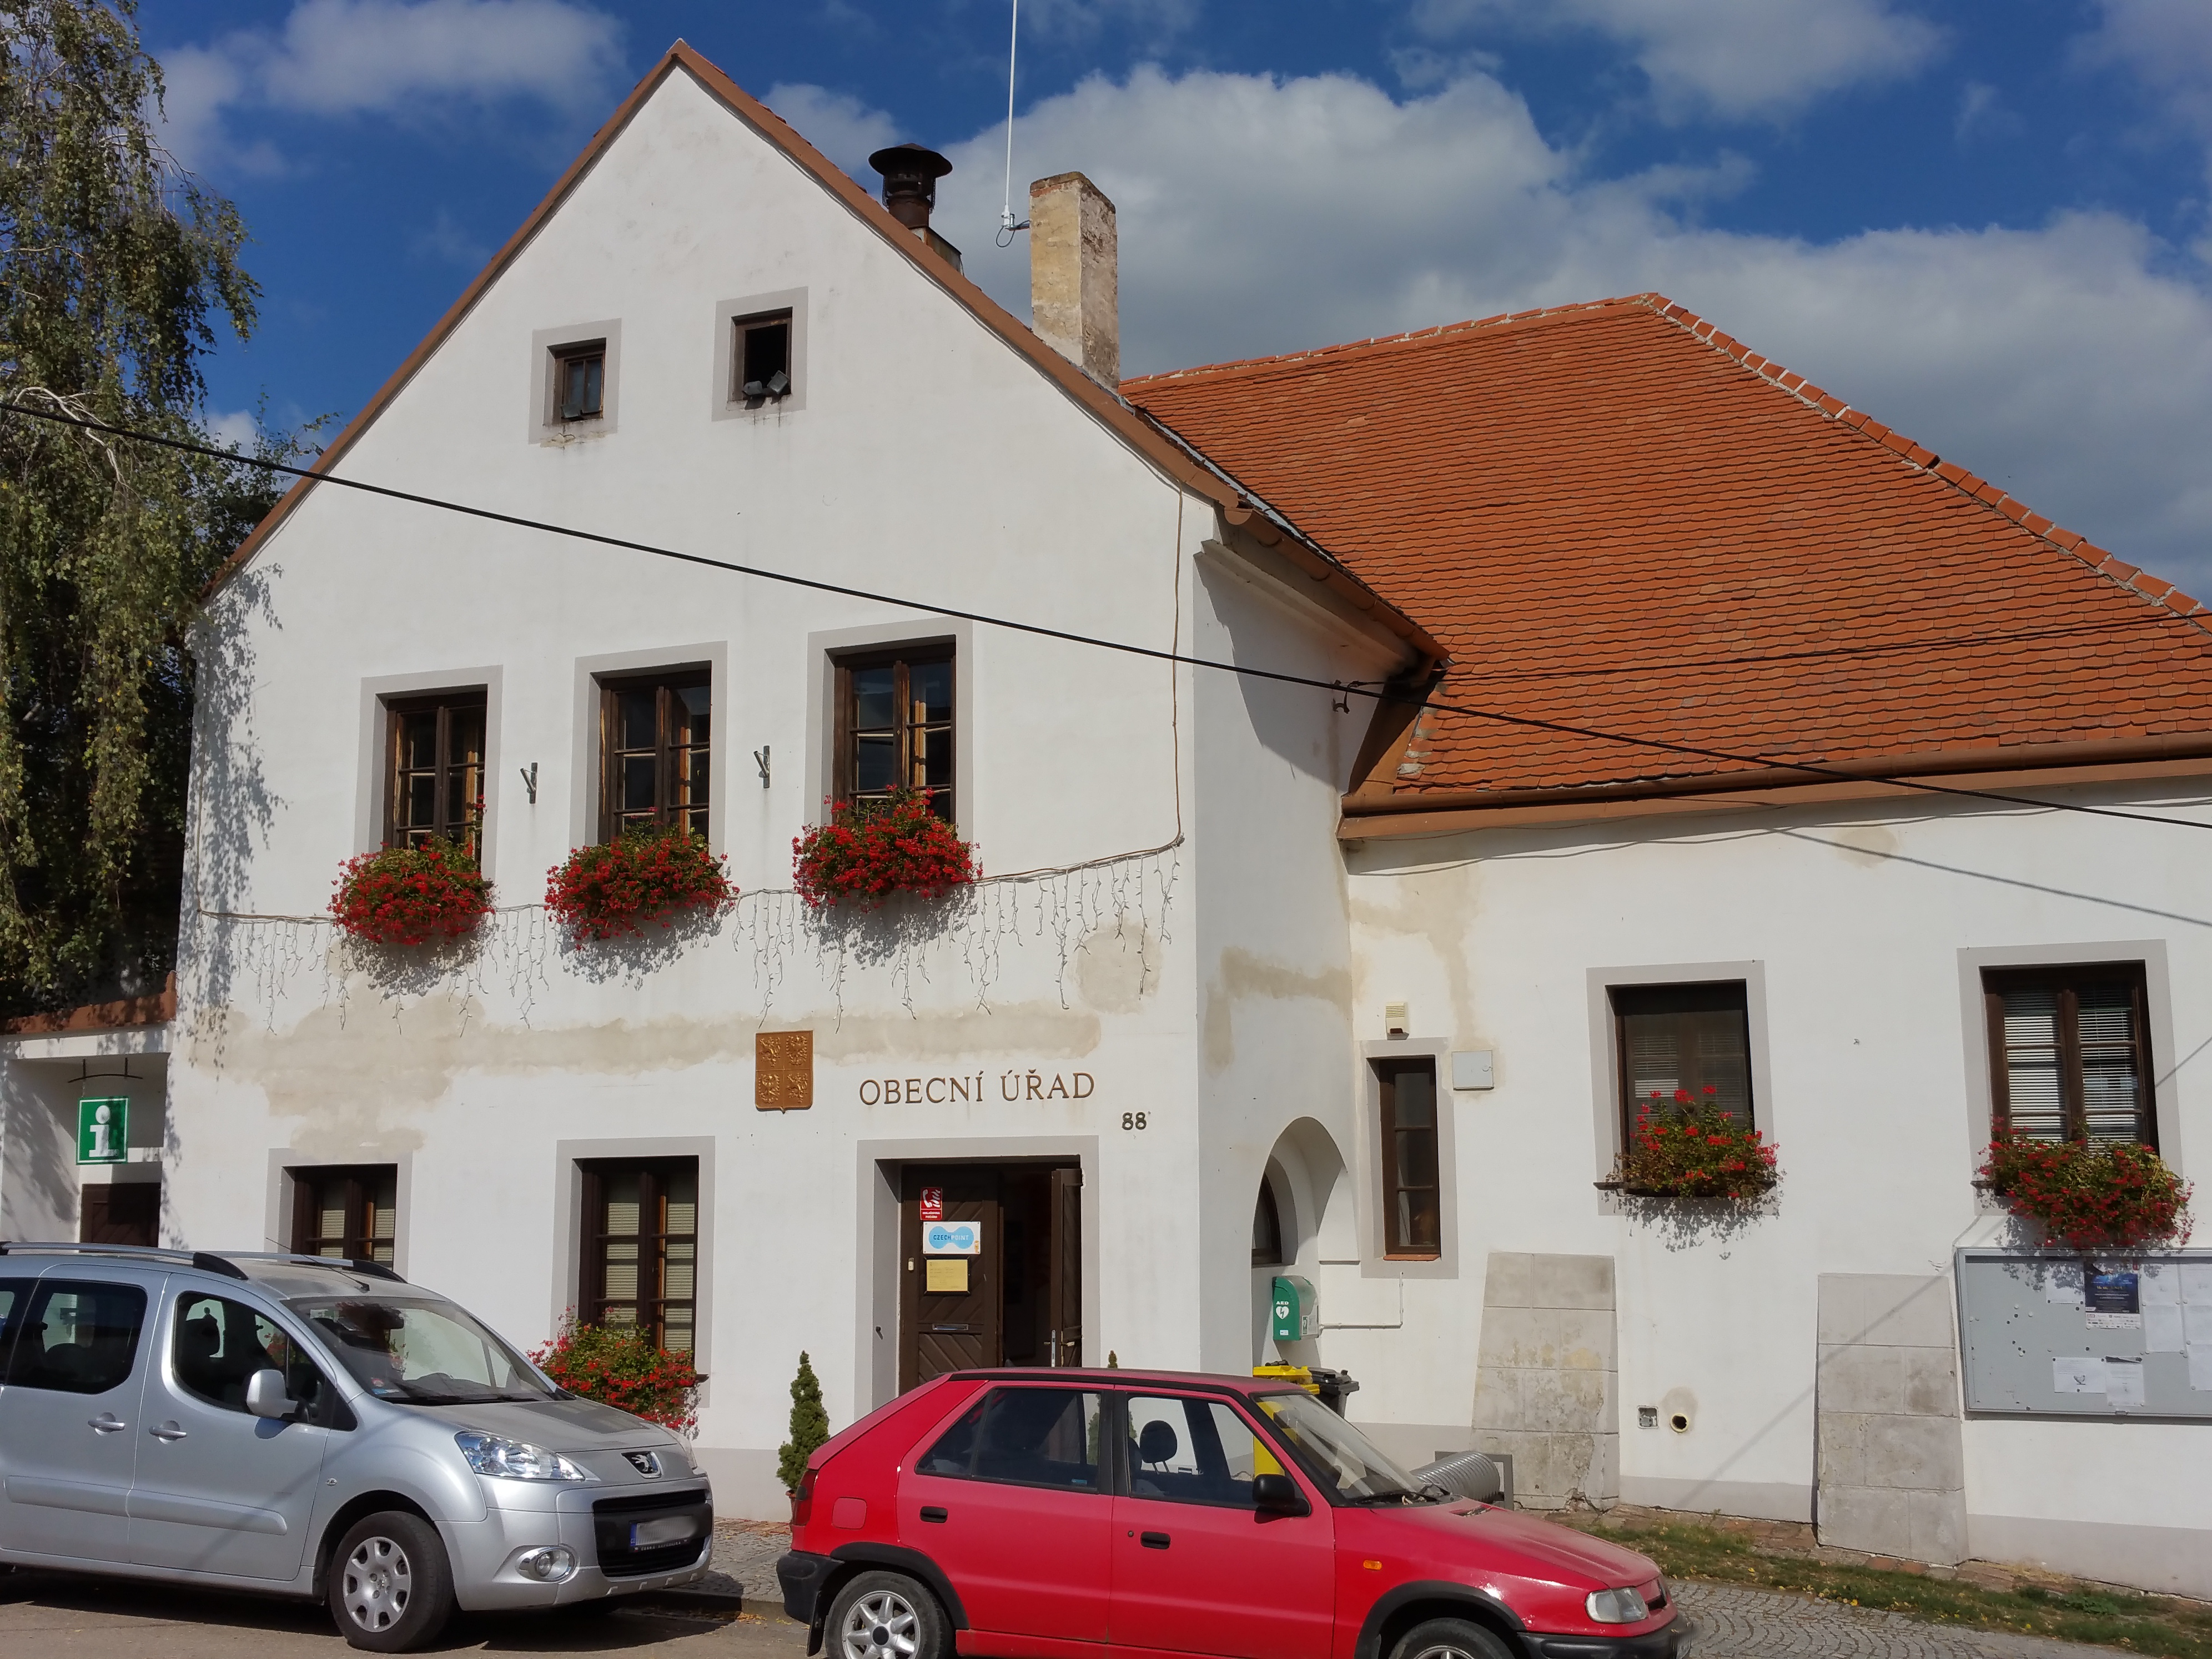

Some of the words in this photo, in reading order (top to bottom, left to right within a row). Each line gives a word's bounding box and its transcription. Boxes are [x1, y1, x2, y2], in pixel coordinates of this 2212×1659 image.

[859, 1069, 984, 1106] OBECNÍ
[1000, 1068, 1095, 1102] ÚŘAD
[1121, 1112, 1147, 1130] 88
